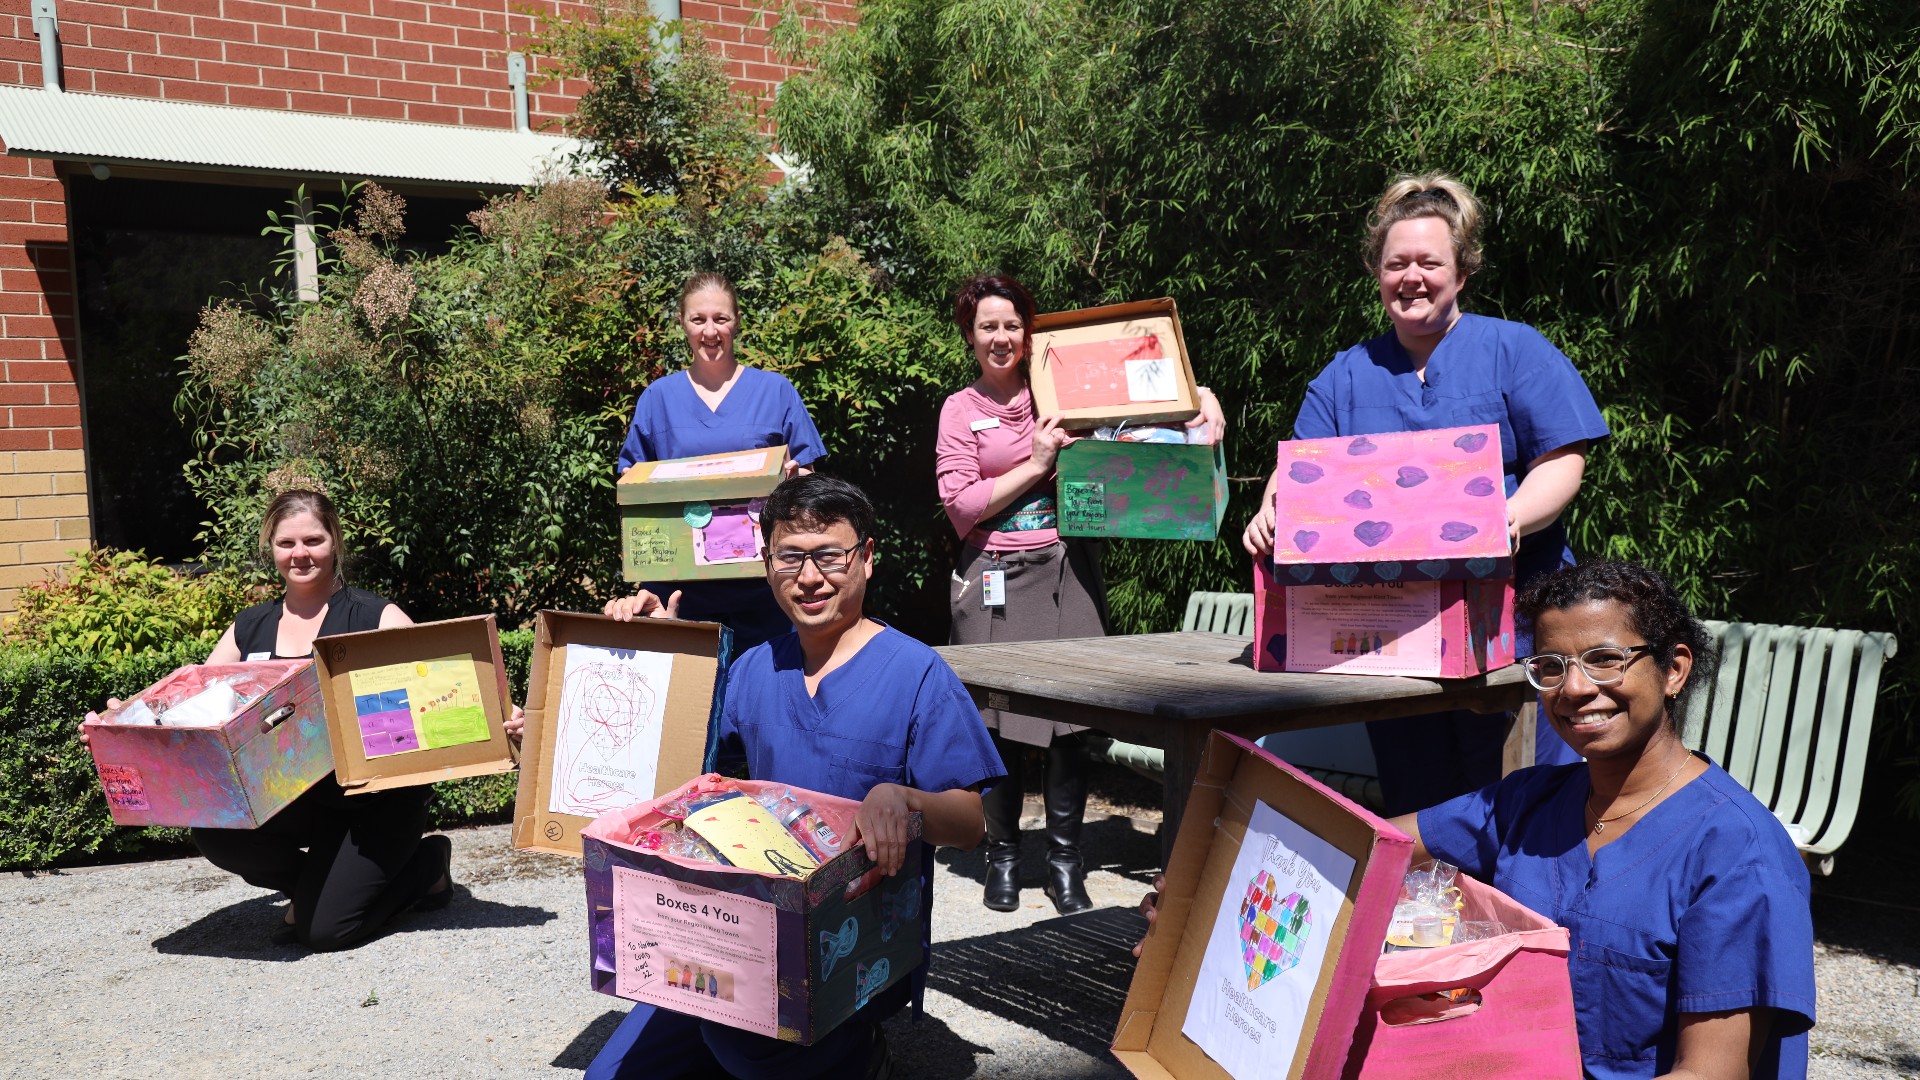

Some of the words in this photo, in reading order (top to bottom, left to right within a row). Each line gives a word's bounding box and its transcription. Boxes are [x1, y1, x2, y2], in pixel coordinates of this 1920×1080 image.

[633, 550, 647, 559] your
[579, 762, 637, 779] Healthcare
[588, 776, 625, 791] Heroes
[1262, 835, 1298, 876] Thank
[1296, 860, 1321, 893] You
[656, 893, 697, 914] Boxes
[701, 904, 709, 917] 4
[712, 906, 739, 925] You
[657, 913, 670, 921] from
[683, 919, 708, 930] Regional
[721, 929, 740, 938] Towns
[628, 941, 636, 951] To
[1221, 977, 1276, 1034] Healthcare
[1225, 1003, 1261, 1044] Heroes
